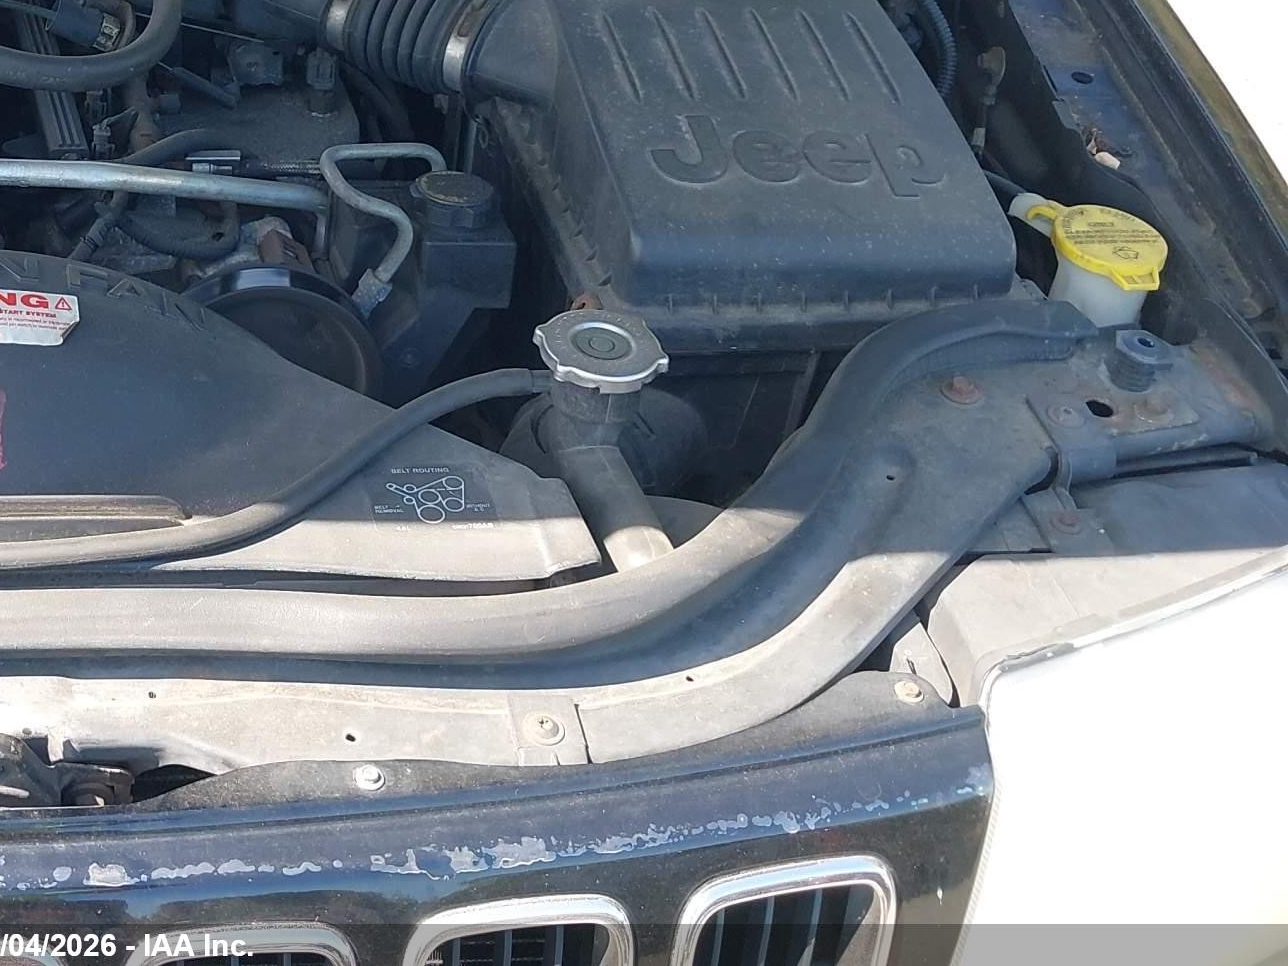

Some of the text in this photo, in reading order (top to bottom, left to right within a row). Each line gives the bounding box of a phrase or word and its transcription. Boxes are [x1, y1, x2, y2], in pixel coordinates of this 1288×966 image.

[647, 113, 947, 198] Jeep
[25, 311, 57, 319] SYSTEM
[66, 263, 209, 332] FAN
